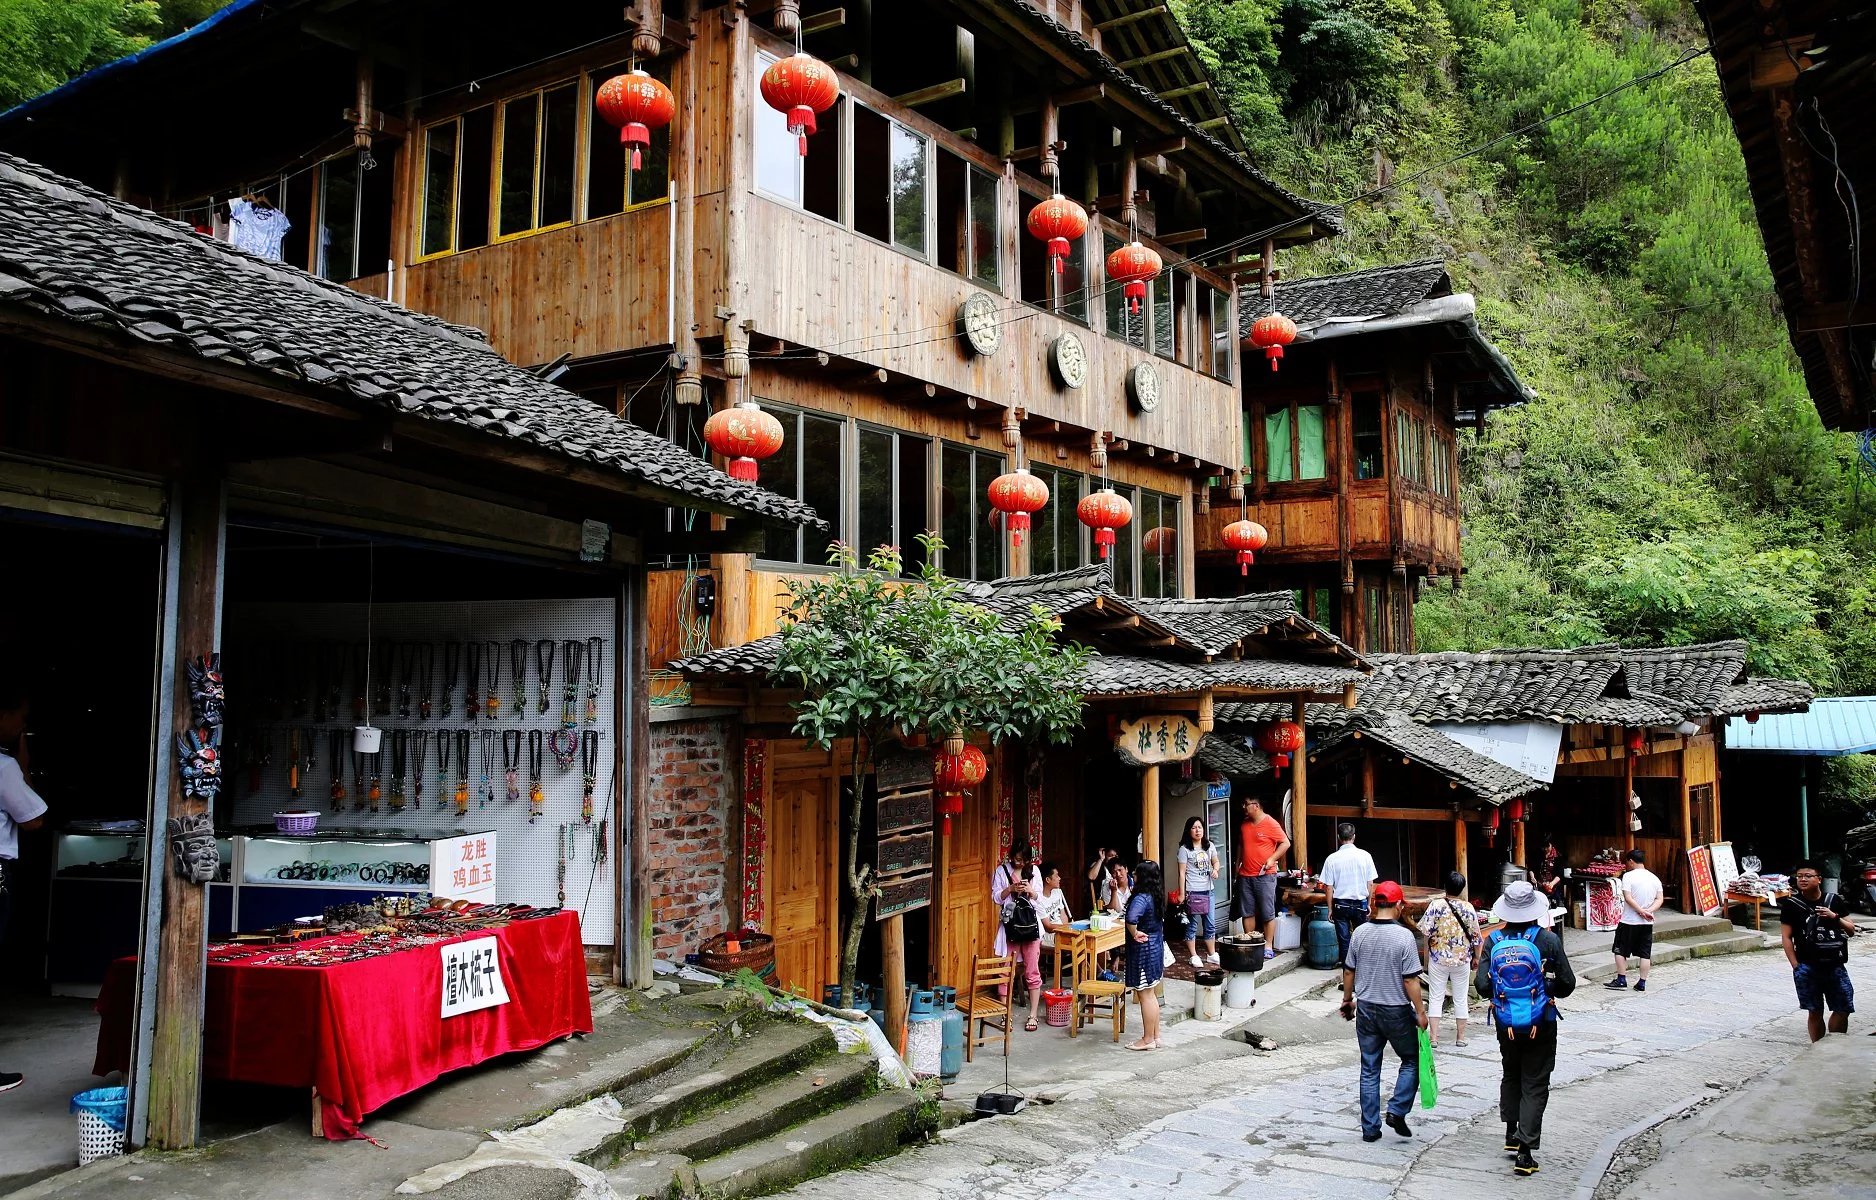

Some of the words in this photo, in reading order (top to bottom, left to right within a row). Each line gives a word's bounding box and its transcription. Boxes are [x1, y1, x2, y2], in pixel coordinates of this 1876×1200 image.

[461, 840, 487, 862] 龙胜
[453, 863, 493, 889] 鸡血玉
[446, 948, 495, 1007] 檀木梳子
